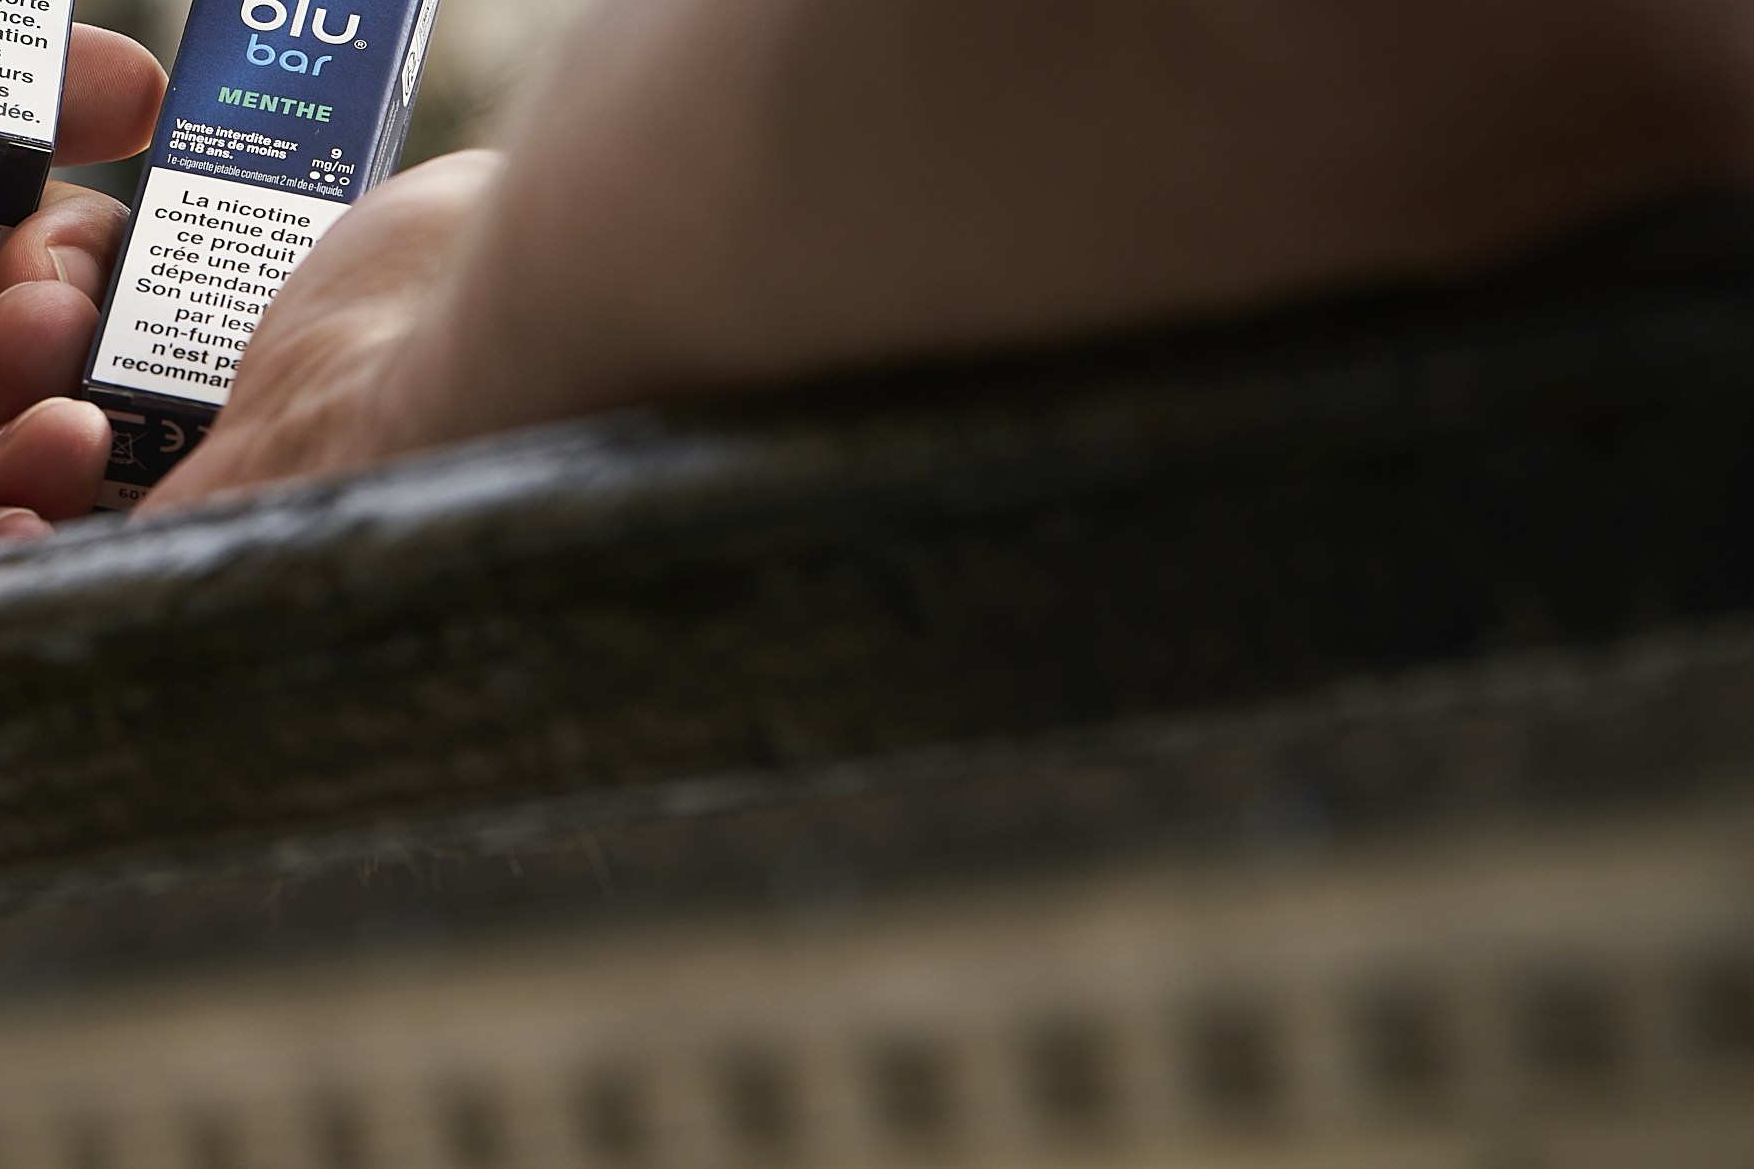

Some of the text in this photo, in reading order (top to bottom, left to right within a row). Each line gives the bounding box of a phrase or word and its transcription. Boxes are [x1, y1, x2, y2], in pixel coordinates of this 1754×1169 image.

[246, 34, 332, 76] bar
[218, 86, 332, 122] MENTHE
[169, 139, 234, 160] de 18 ans.
[172, 130, 286, 160] mineurs de moins
[176, 118, 298, 151] Vente interdite aux
[312, 158, 354, 174] mg/ml
[330, 148, 342, 159] 9
[172, 157, 214, 169] e-cigarette
[214, 162, 241, 176] jetable
[241, 169, 279, 184] contenant
[280, 175, 286, 186] 2
[286, 178, 297, 188] ml
[298, 178, 308, 190] de
[308, 182, 344, 196] e-liquide.
[182, 190, 311, 228] La nicotine
[154, 207, 320, 248] contenue dan
[150, 244, 291, 281] crée une for
[177, 230, 296, 264] ce produit
[136, 278, 181, 298] Son
[150, 262, 280, 299] dépendanc
[134, 320, 248, 352] non-fume
[174, 308, 256, 333] par les
[152, 343, 243, 370] n'est pa
